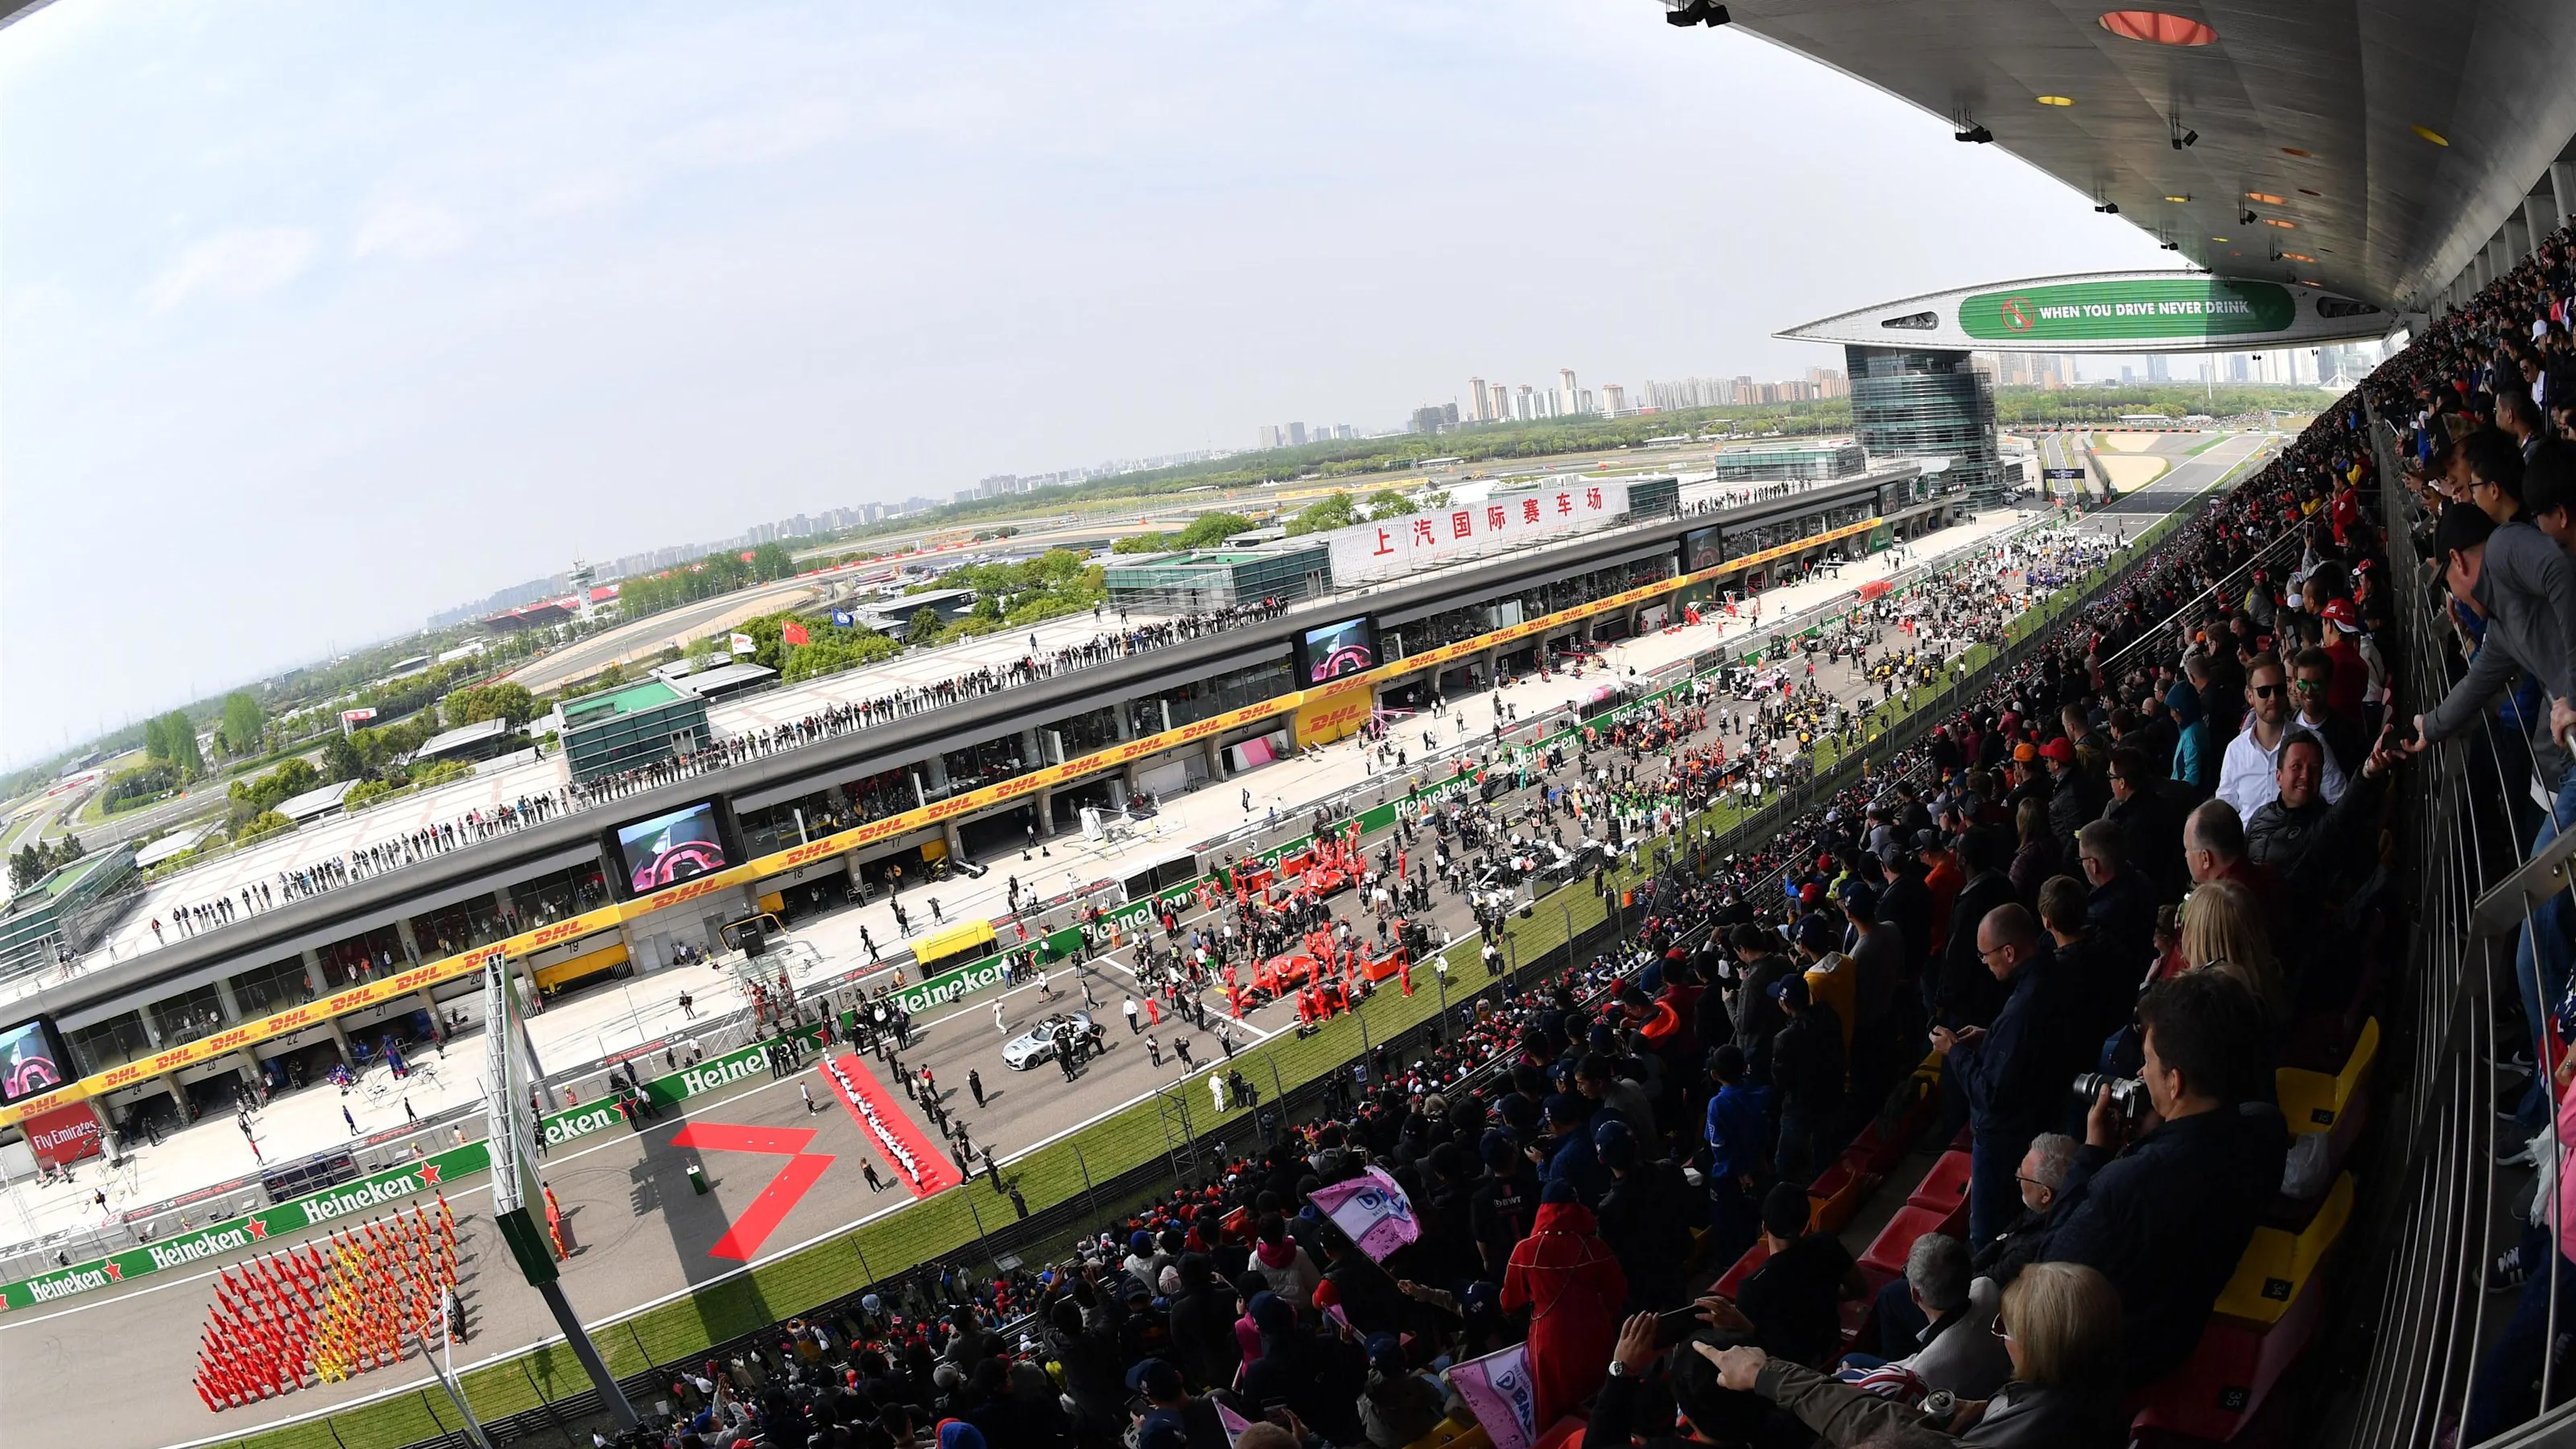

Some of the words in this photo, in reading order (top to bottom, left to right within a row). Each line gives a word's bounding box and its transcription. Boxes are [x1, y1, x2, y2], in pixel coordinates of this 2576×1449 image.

[2040, 306, 2080, 320] WHEN
[2083, 304, 2112, 318] YOU
[2116, 302, 2155, 316] DRIVE
[2159, 301, 2202, 316] NEVER
[2206, 300, 2250, 314] DRINK
[1373, 487, 1602, 556] 上汽国际赛车场
[1738, 557, 1753, 567] DHL
[1624, 590, 1643, 602] DHL
[1652, 581, 1671, 593] DHL
[1562, 609, 1583, 621] DHL
[1594, 599, 1615, 611] DHL
[1527, 618, 1550, 632] DHL
[1491, 629, 1516, 643] DHL
[1451, 640, 1478, 655] DHL
[1409, 653, 1439, 669] DHL
[1324, 675, 1370, 697] DHL
[1239, 703, 1274, 721] DHL
[1310, 705, 1358, 733] DHL
[1183, 720, 1220, 740] DHL
[1124, 738, 1163, 758] DHL
[1163, 752, 1171, 761] 14
[1062, 756, 1104, 778] DHL
[996, 775, 1041, 798] DHL
[928, 797, 974, 819] DHL
[858, 818, 906, 841] DHL
[786, 840, 835, 864] DHL
[891, 836, 901, 848] 17
[793, 869, 803, 880] 18
[652, 878, 720, 909] DHL
[535, 921, 583, 945] DHL
[464, 943, 511, 968] DHL
[568, 942, 579, 954] 19
[396, 966, 442, 990] DHL
[470, 973, 481, 985] 20
[330, 989, 374, 1012] DHL
[269, 1009, 311, 1032] DHL
[376, 1005, 386, 1017] 21
[210, 1030, 250, 1051] DHL
[287, 1034, 299, 1046] 22
[156, 1048, 194, 1069] DHL
[207, 1061, 216, 1071] 23
[105, 1067, 141, 1086] DHL
[133, 1086, 142, 1096] 24
[20, 1095, 64, 1117] DHL
[32, 1131, 53, 1151] Fly
[55, 1118, 98, 1146] Emirates
[299, 1173, 417, 1224] Heineken
[1502, 1195, 1521, 1207] BWT
[148, 1225, 247, 1269] Heineken
[27, 1269, 106, 1302] Heineken
[2271, 1282, 2286, 1297] 34
[2226, 1390, 2244, 1408] 35
